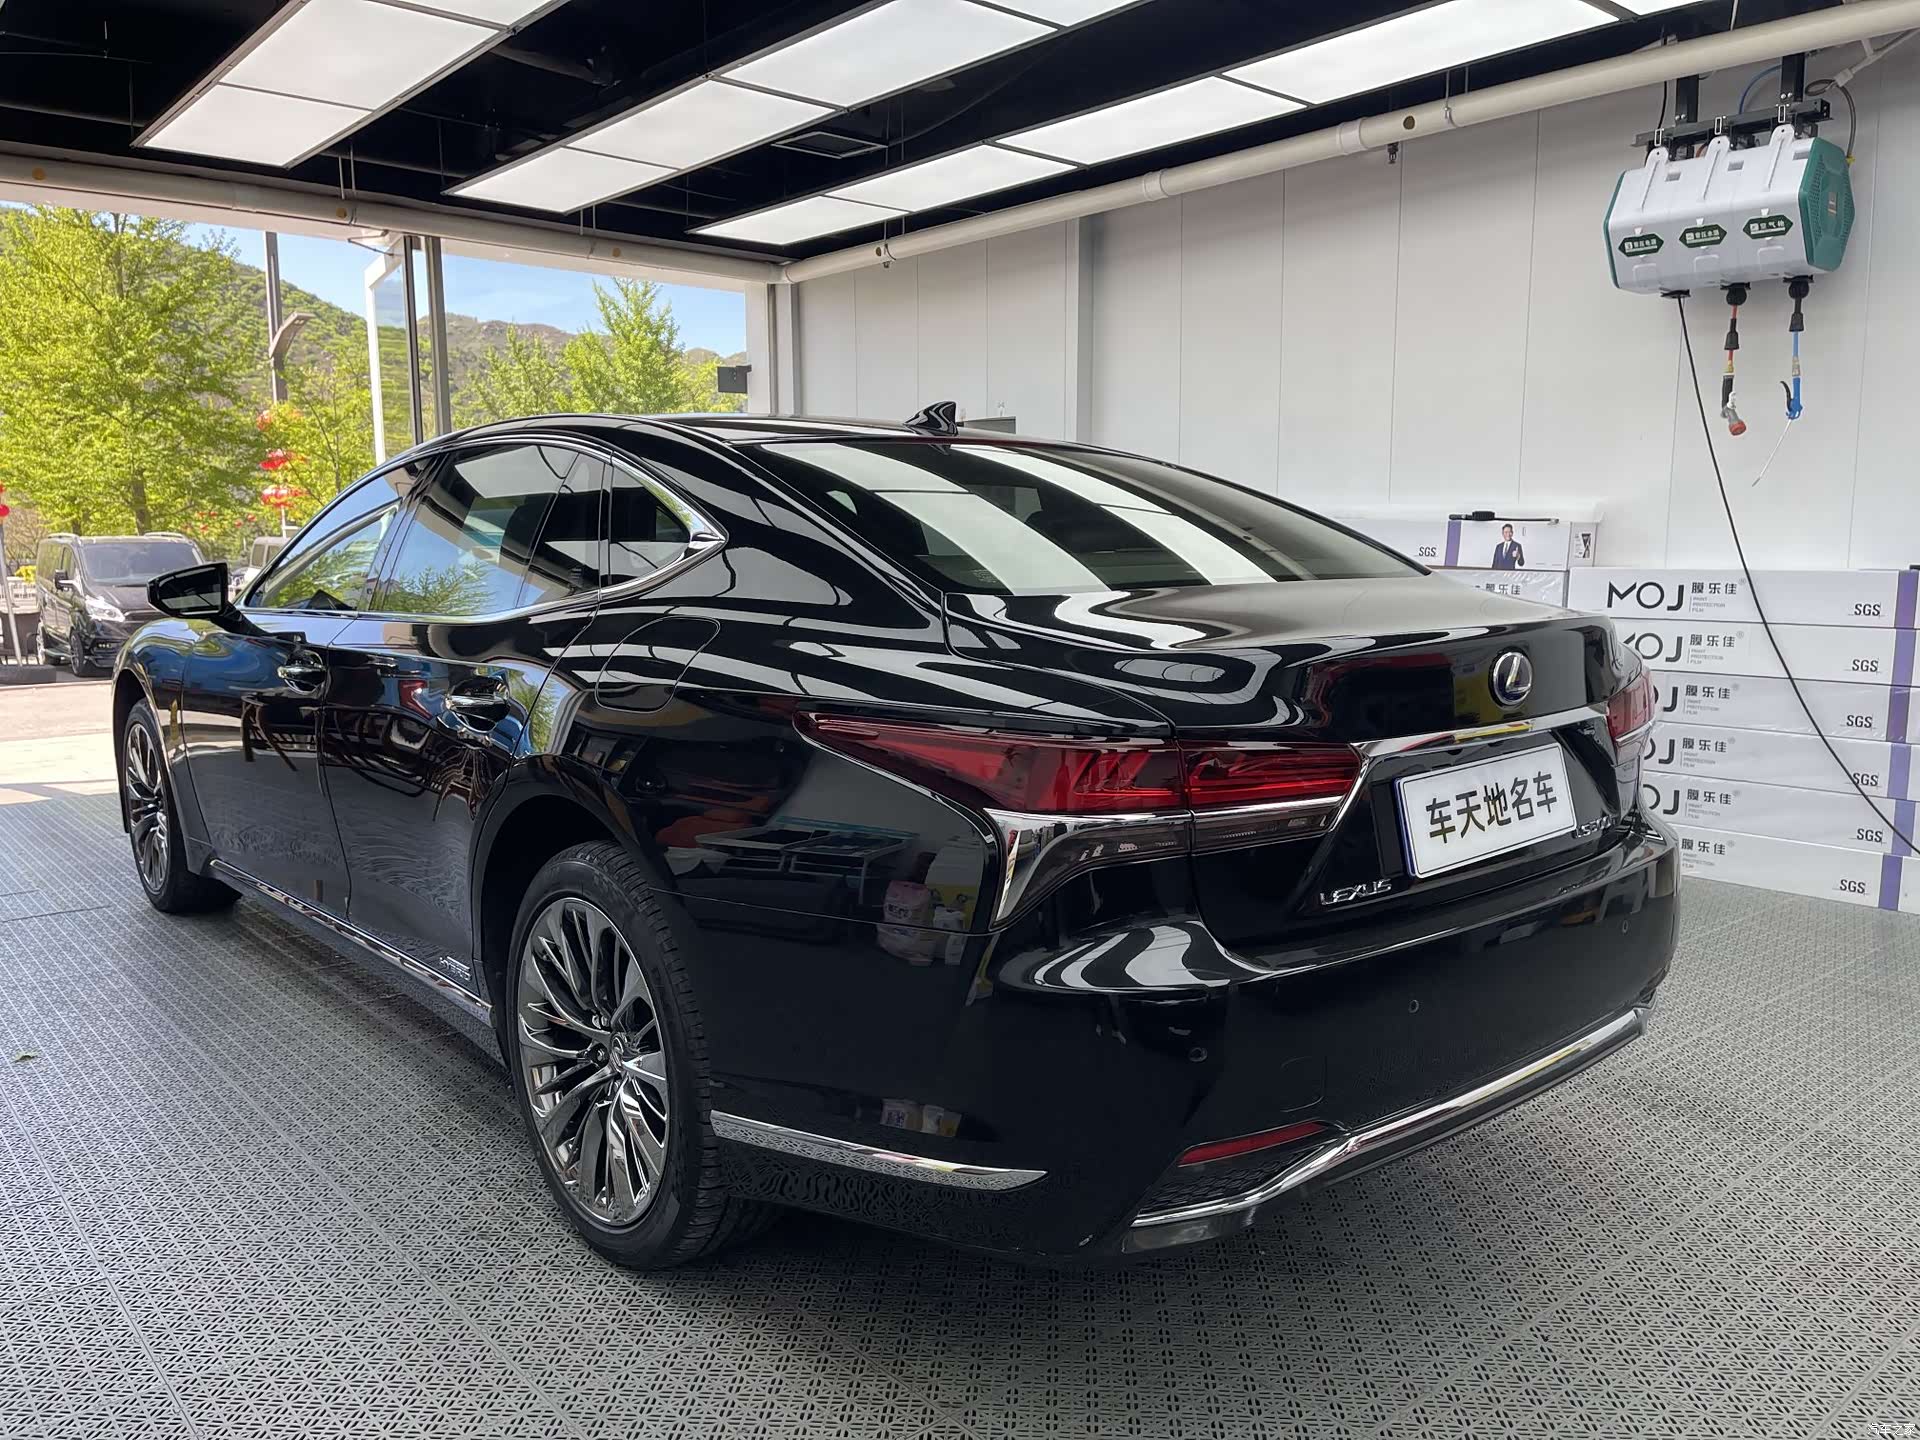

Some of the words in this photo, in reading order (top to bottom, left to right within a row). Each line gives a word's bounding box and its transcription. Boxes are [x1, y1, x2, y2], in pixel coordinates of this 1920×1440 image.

[1418, 547, 1437, 557] SGS
[1607, 581, 1684, 611] MOJ
[1854, 603, 1881, 617] SGS
[1852, 659, 1879, 673] SGS
[1846, 715, 1873, 729] SGS
[1852, 772, 1879, 787] SGS
[1425, 771, 1558, 844] 车天地名车
[1857, 828, 1883, 843] SGS
[1319, 878, 1393, 906] LEXUS
[1840, 879, 1866, 894] SGS
